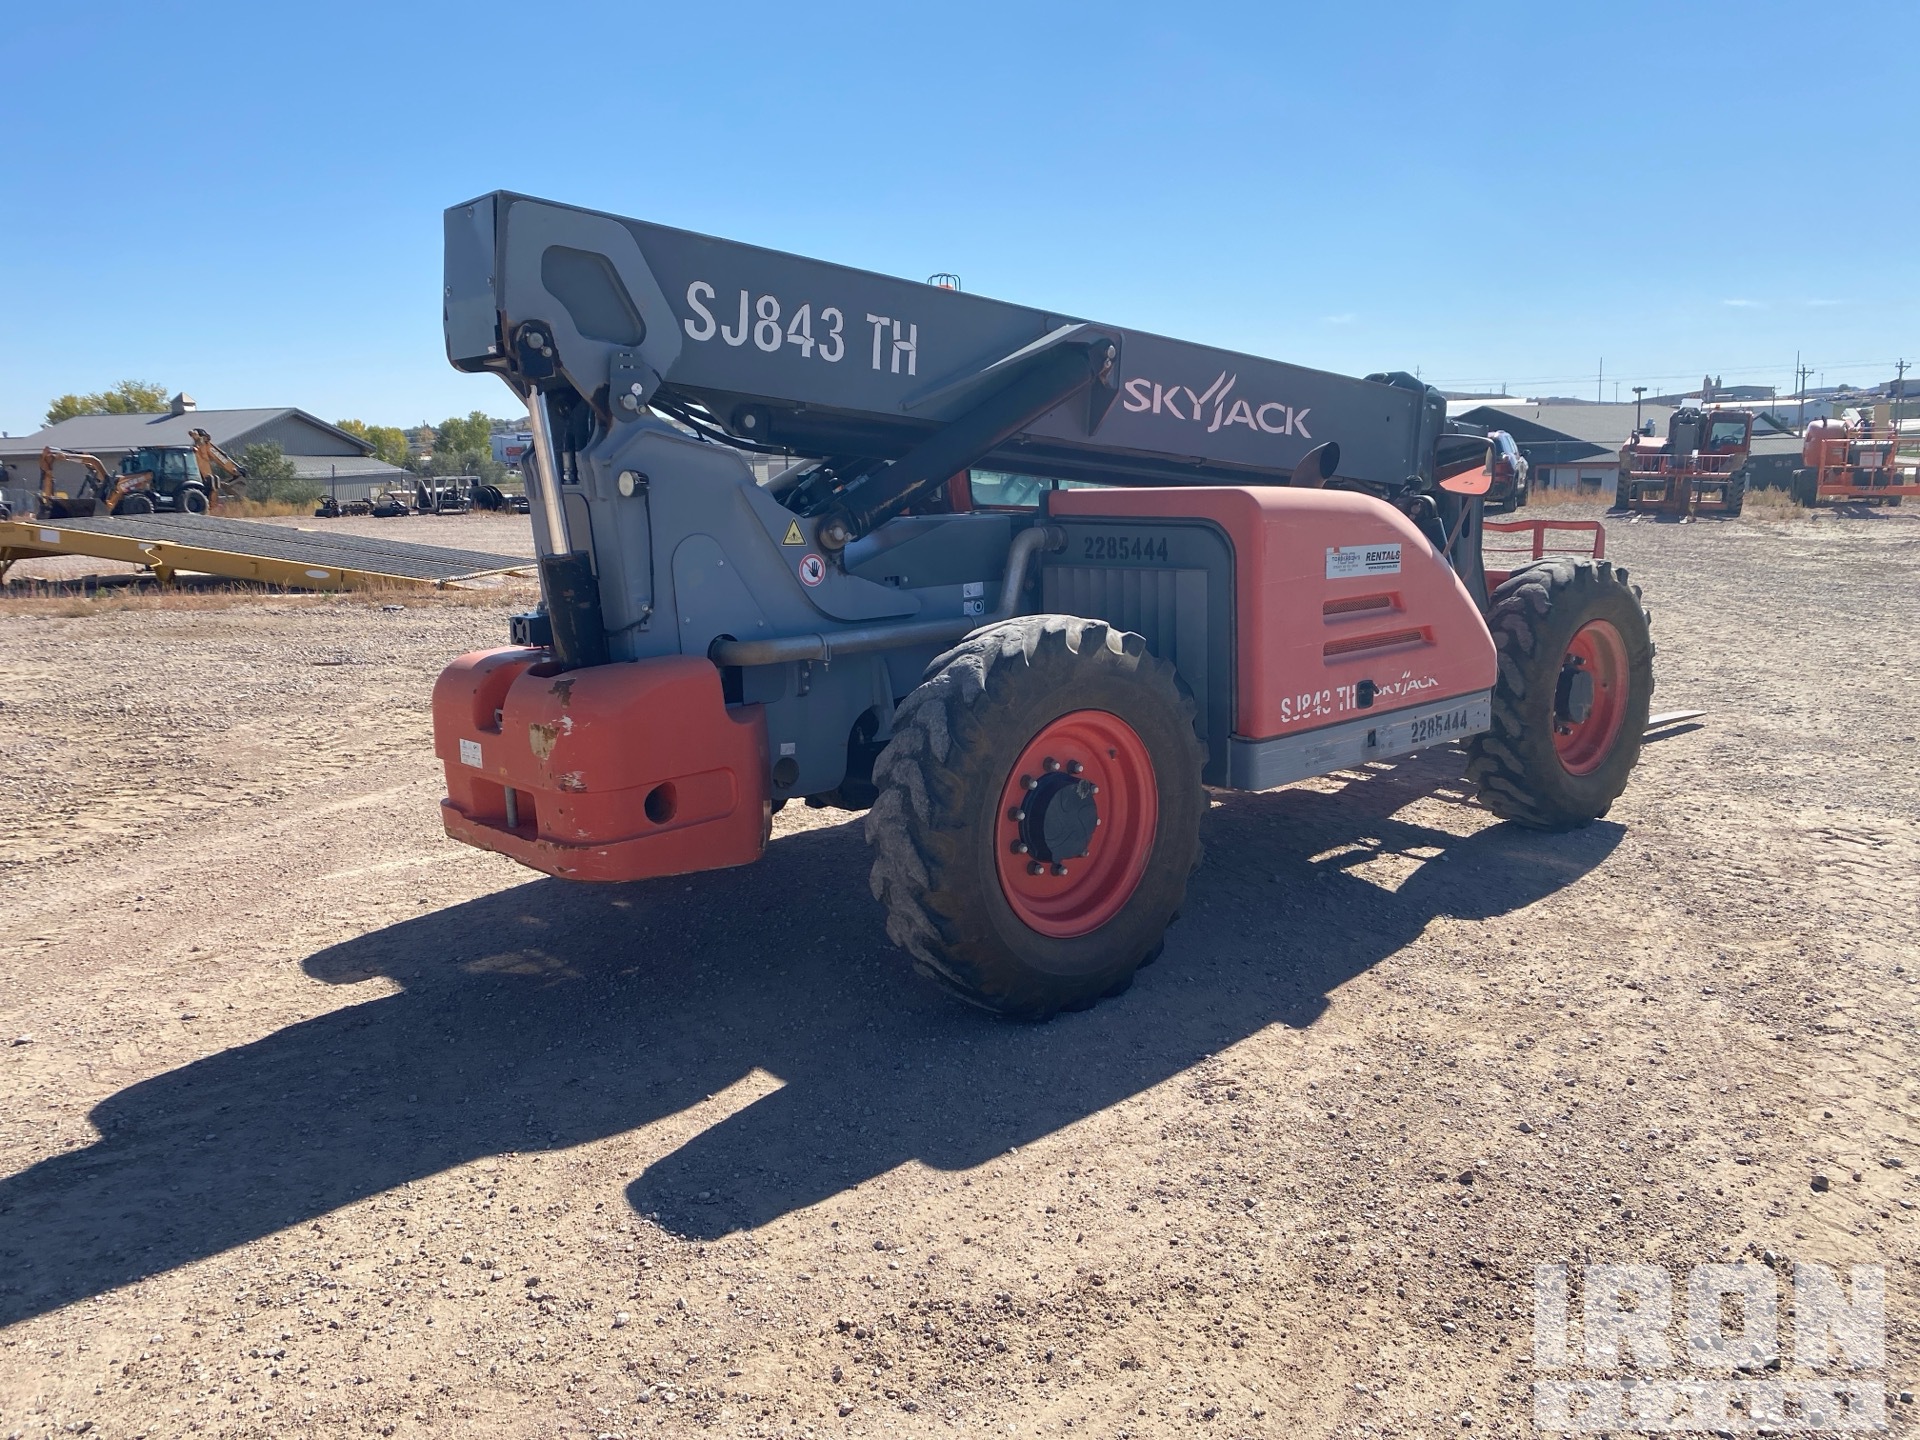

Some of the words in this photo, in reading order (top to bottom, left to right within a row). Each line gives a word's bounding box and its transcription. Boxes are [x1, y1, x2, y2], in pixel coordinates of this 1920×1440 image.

[684, 280, 845, 363] SJ843
[866, 313, 918, 376] TH
[1123, 370, 1312, 439] SKYJACK
[1084, 536, 1168, 562] 2285444
[1365, 550, 1401, 562] RENTALS
[1411, 709, 1468, 744] 2285444
